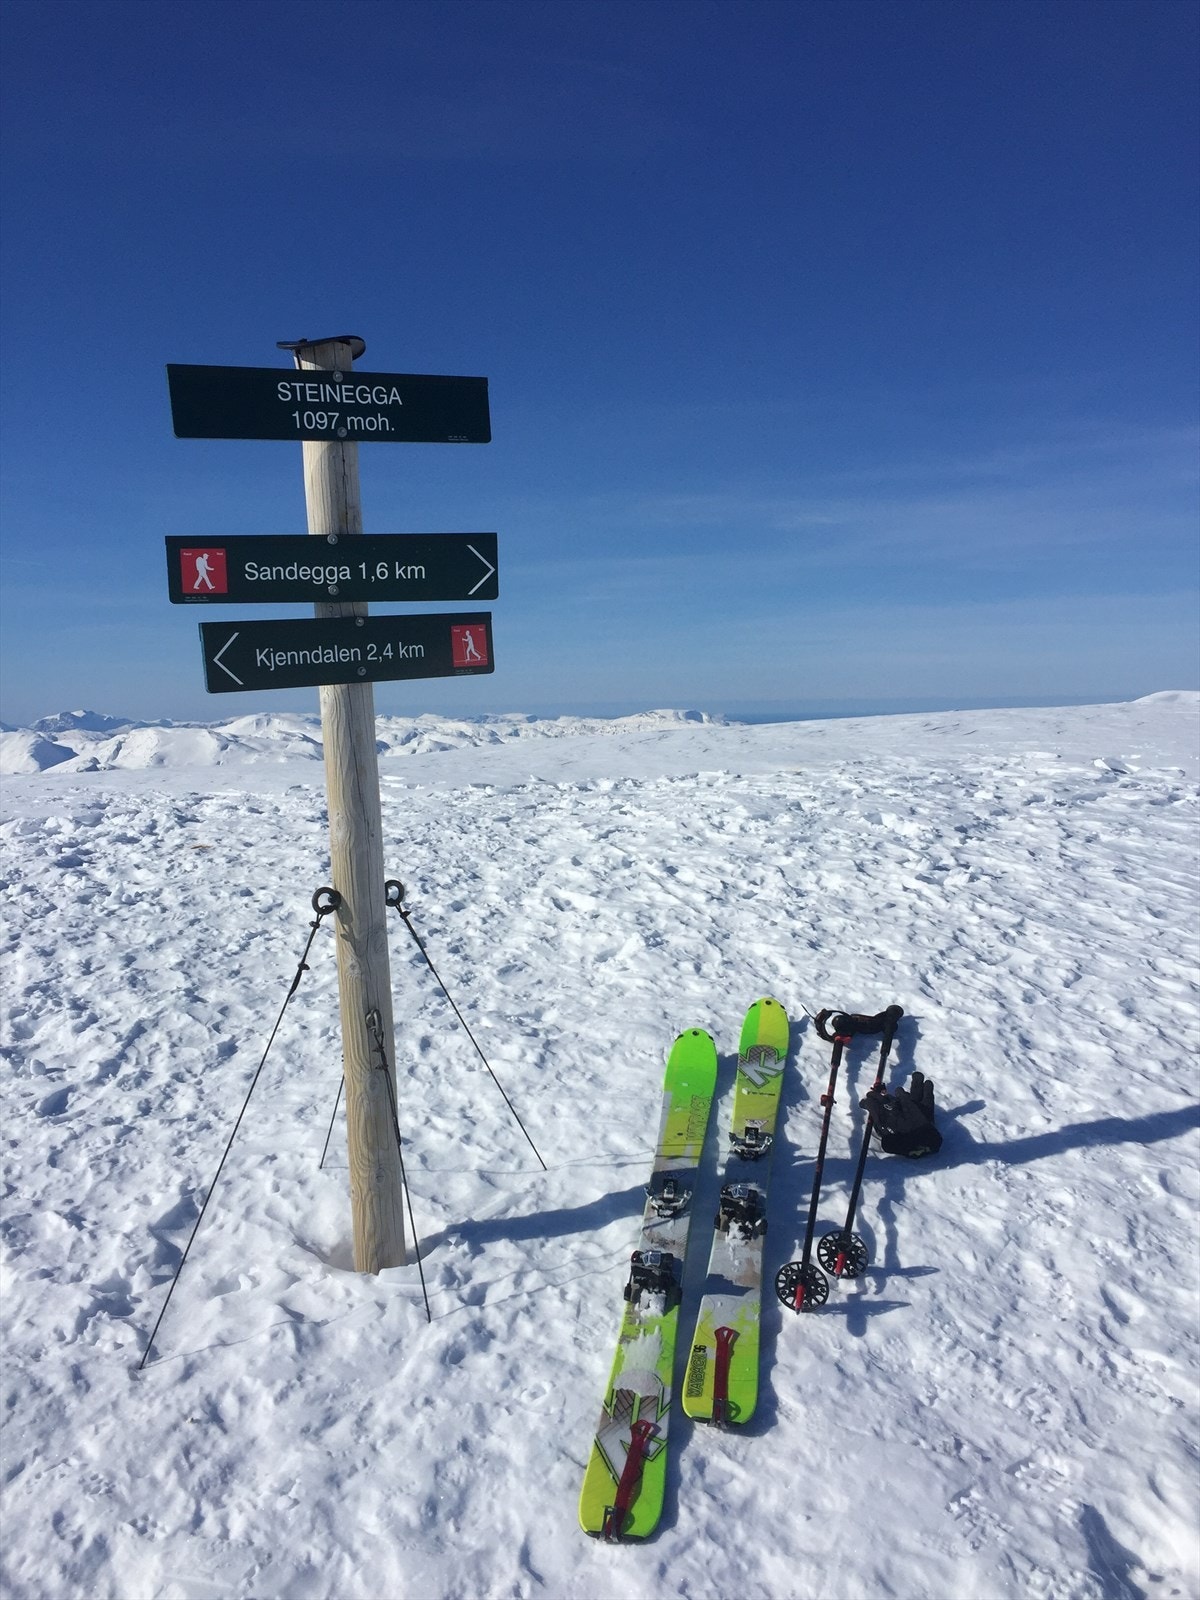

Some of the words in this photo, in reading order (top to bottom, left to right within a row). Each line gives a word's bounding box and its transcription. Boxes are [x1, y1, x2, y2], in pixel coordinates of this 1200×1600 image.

[277, 381, 403, 406] STEINEGGA
[291, 410, 340, 430] 1097
[346, 413, 396, 432] moh.
[244, 561, 352, 585] Sandegga
[358, 561, 390, 583] 1,6
[395, 561, 426, 580] km
[255, 644, 361, 672] Kjenndalen
[366, 642, 394, 664] 2,4
[398, 641, 425, 660] km
